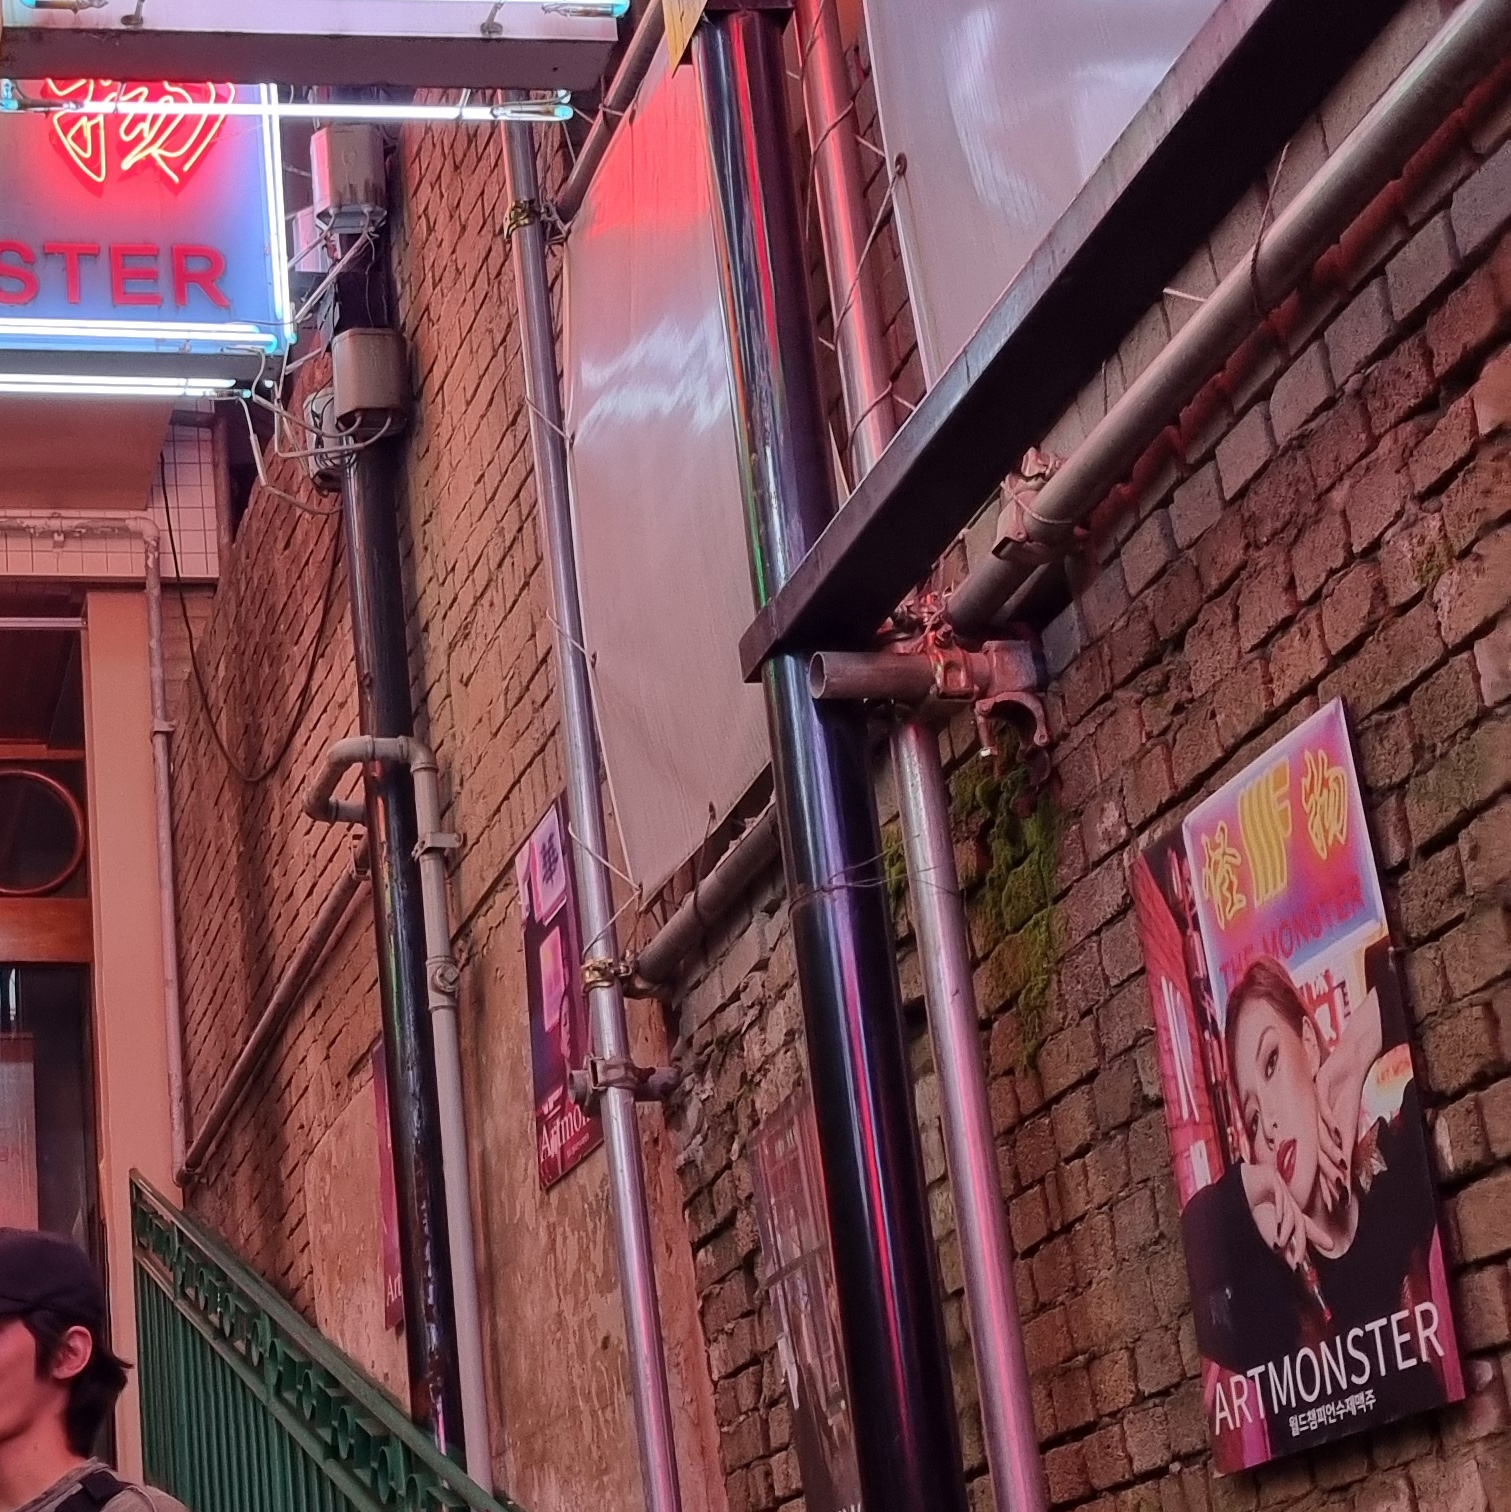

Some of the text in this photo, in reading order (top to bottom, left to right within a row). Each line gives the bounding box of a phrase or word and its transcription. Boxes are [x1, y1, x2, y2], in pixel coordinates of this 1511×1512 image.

[540, 1104, 591, 1163] Artmo
[1214, 1300, 1445, 1436] ARTMONSTER
[1288, 1388, 1377, 1437] 월드챔피언수제맥주
